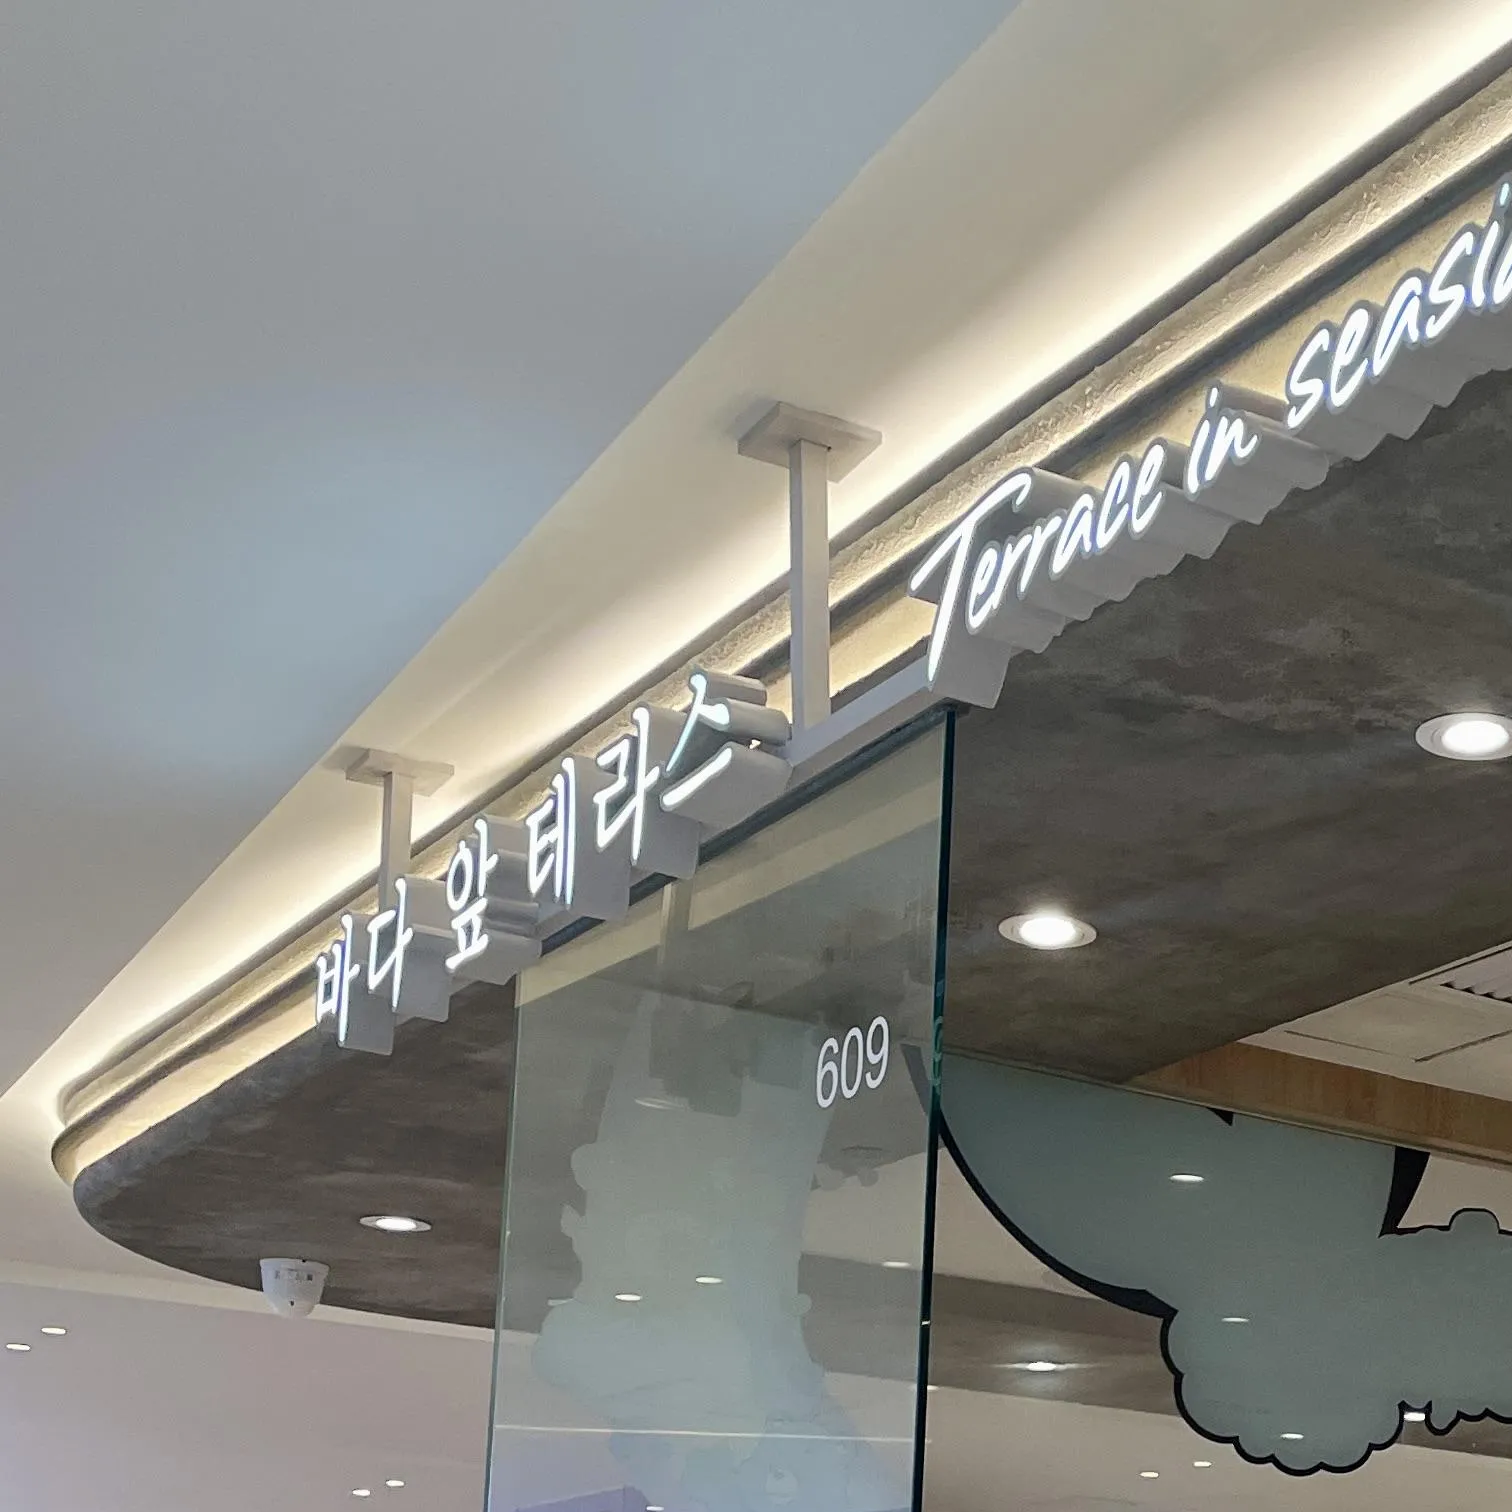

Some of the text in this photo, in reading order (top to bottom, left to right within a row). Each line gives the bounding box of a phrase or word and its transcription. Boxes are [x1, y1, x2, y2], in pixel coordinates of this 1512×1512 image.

[911, 473, 1164, 688] Terrace
[1188, 388, 1260, 488] in
[315, 670, 732, 1046] 바다 앞 테라스
[816, 1016, 890, 1109] 609
